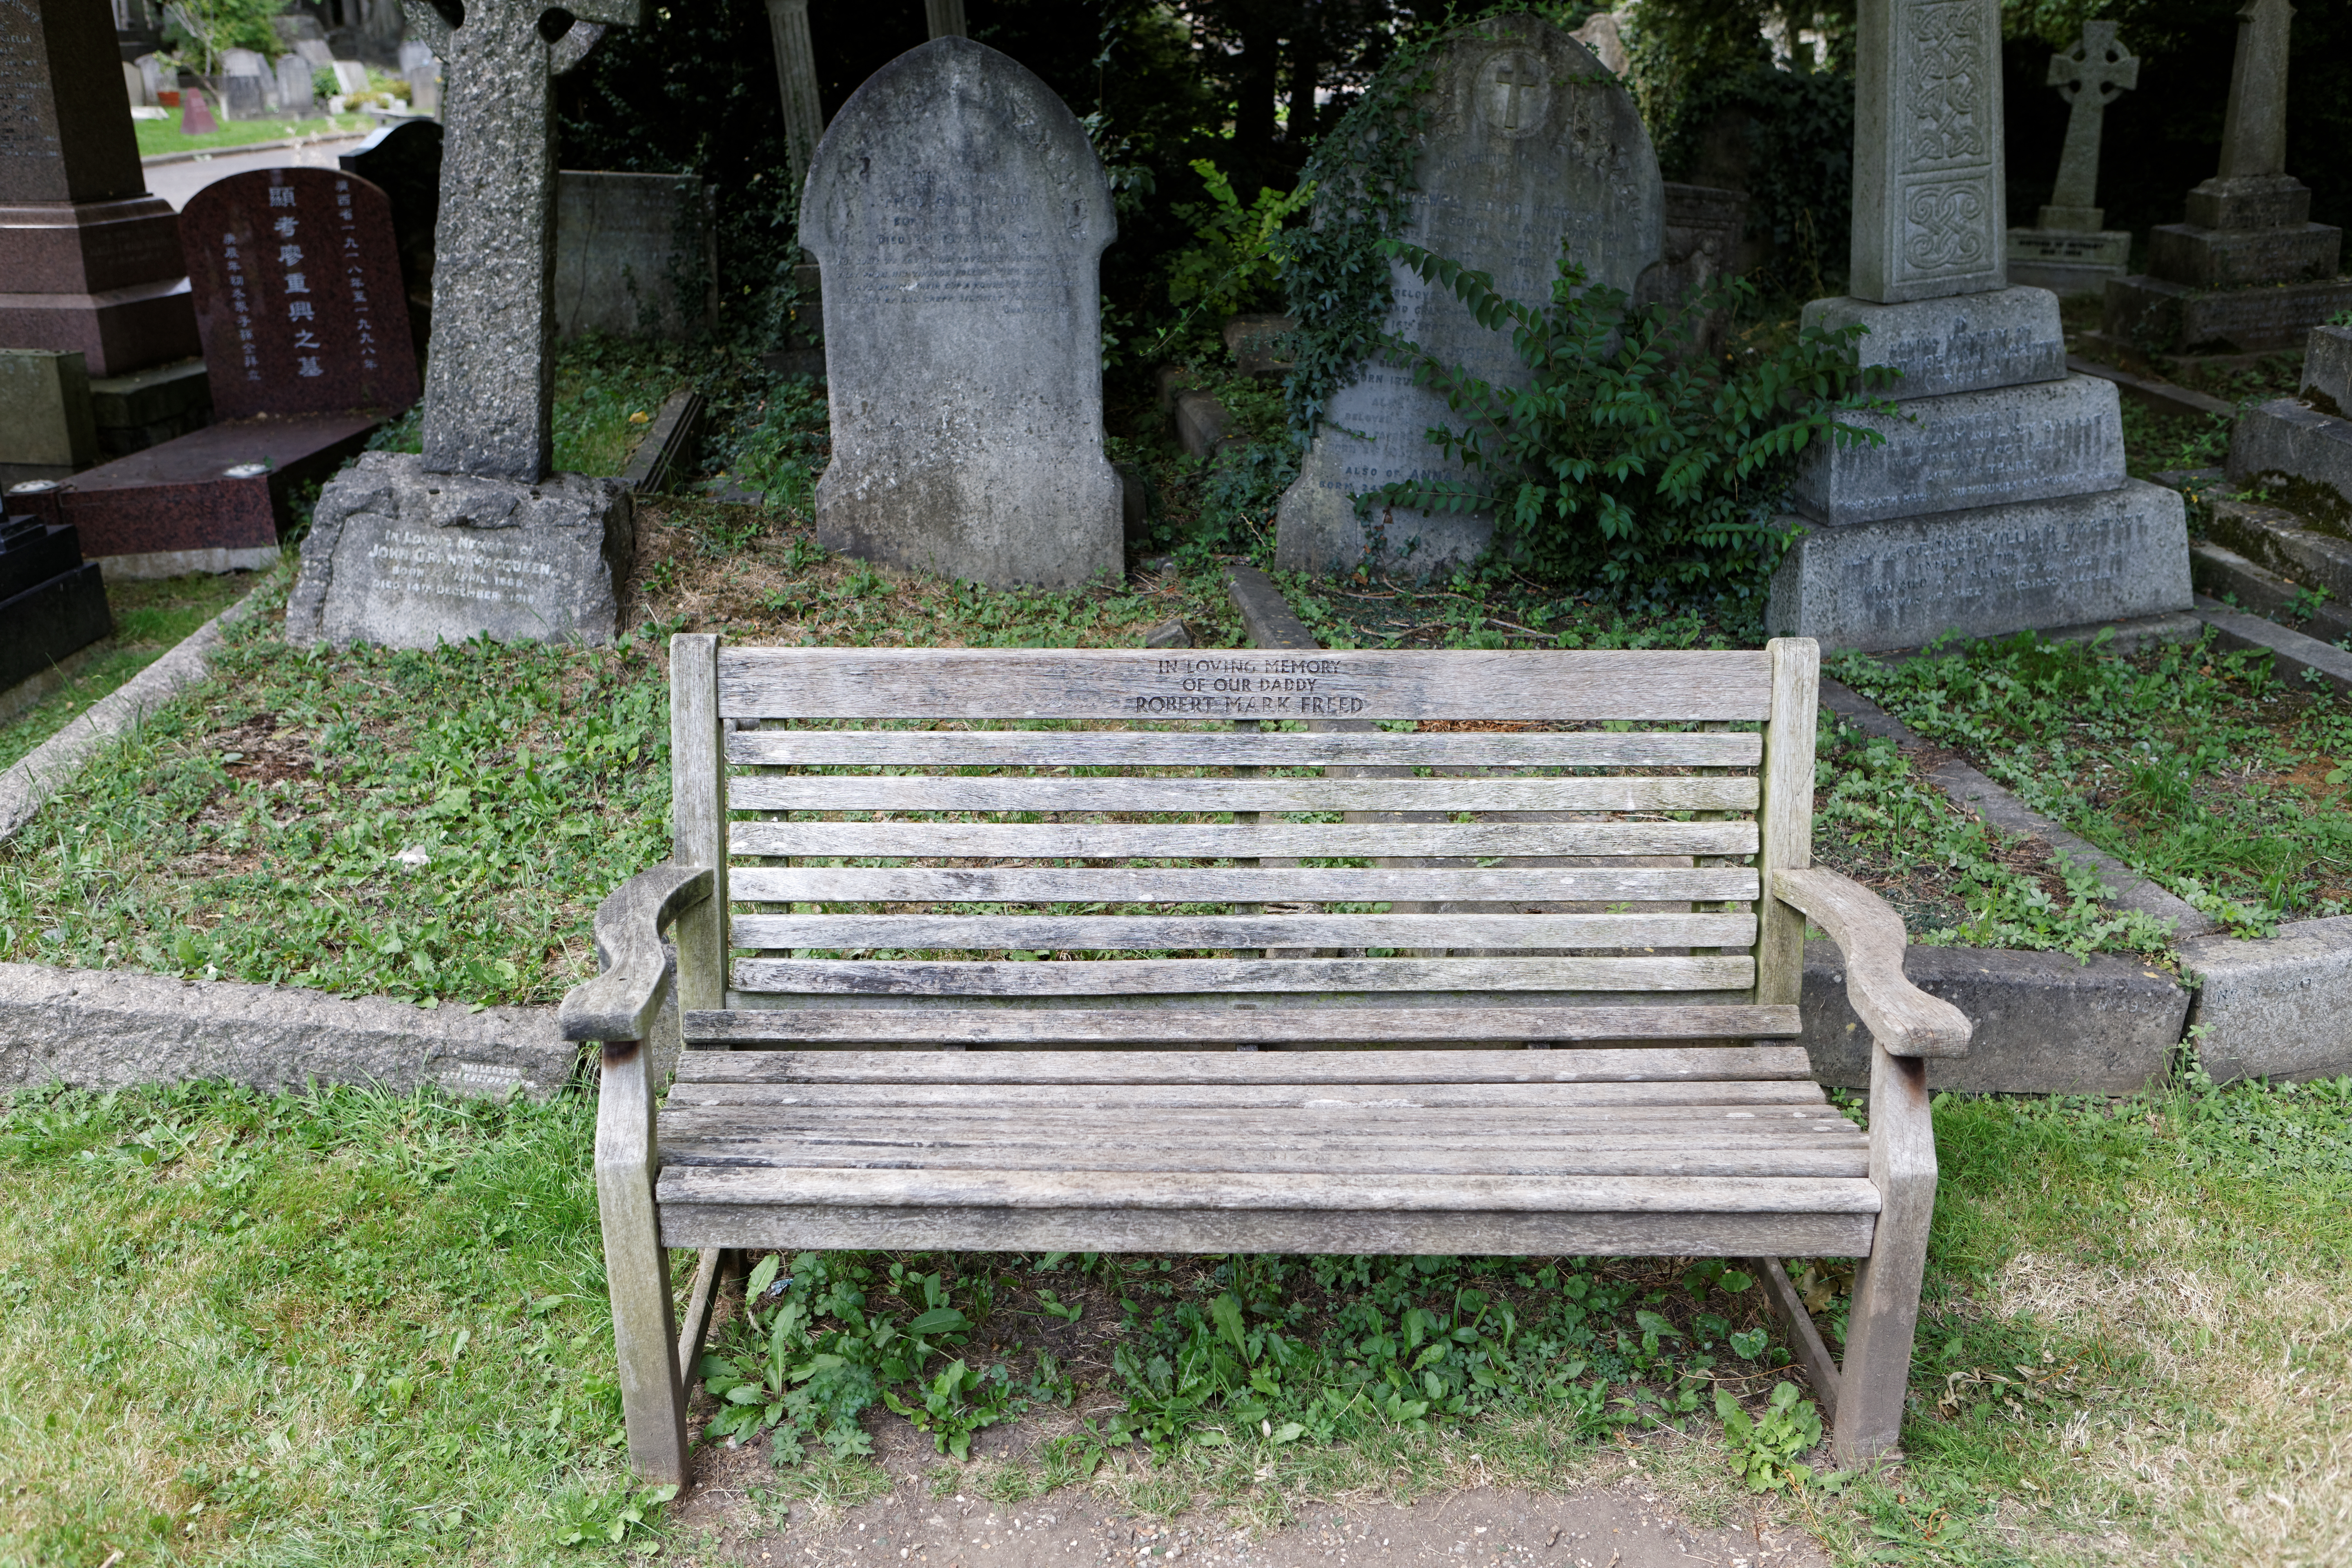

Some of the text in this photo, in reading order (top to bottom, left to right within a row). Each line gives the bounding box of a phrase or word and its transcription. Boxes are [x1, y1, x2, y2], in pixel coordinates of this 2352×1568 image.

[269, 187, 323, 378] 顯考廖重興之墓
[1345, 466, 1378, 477] ALSO
[368, 543, 408, 560] JOHN
[372, 579, 400, 590] DIED
[453, 571, 487, 585] APRIL
[1158, 660, 1341, 674] IN LOVING MEMORY
[1183, 678, 1317, 692] OF OUR DADDY
[1136, 697, 1364, 713] ROBERT MARK FREED
